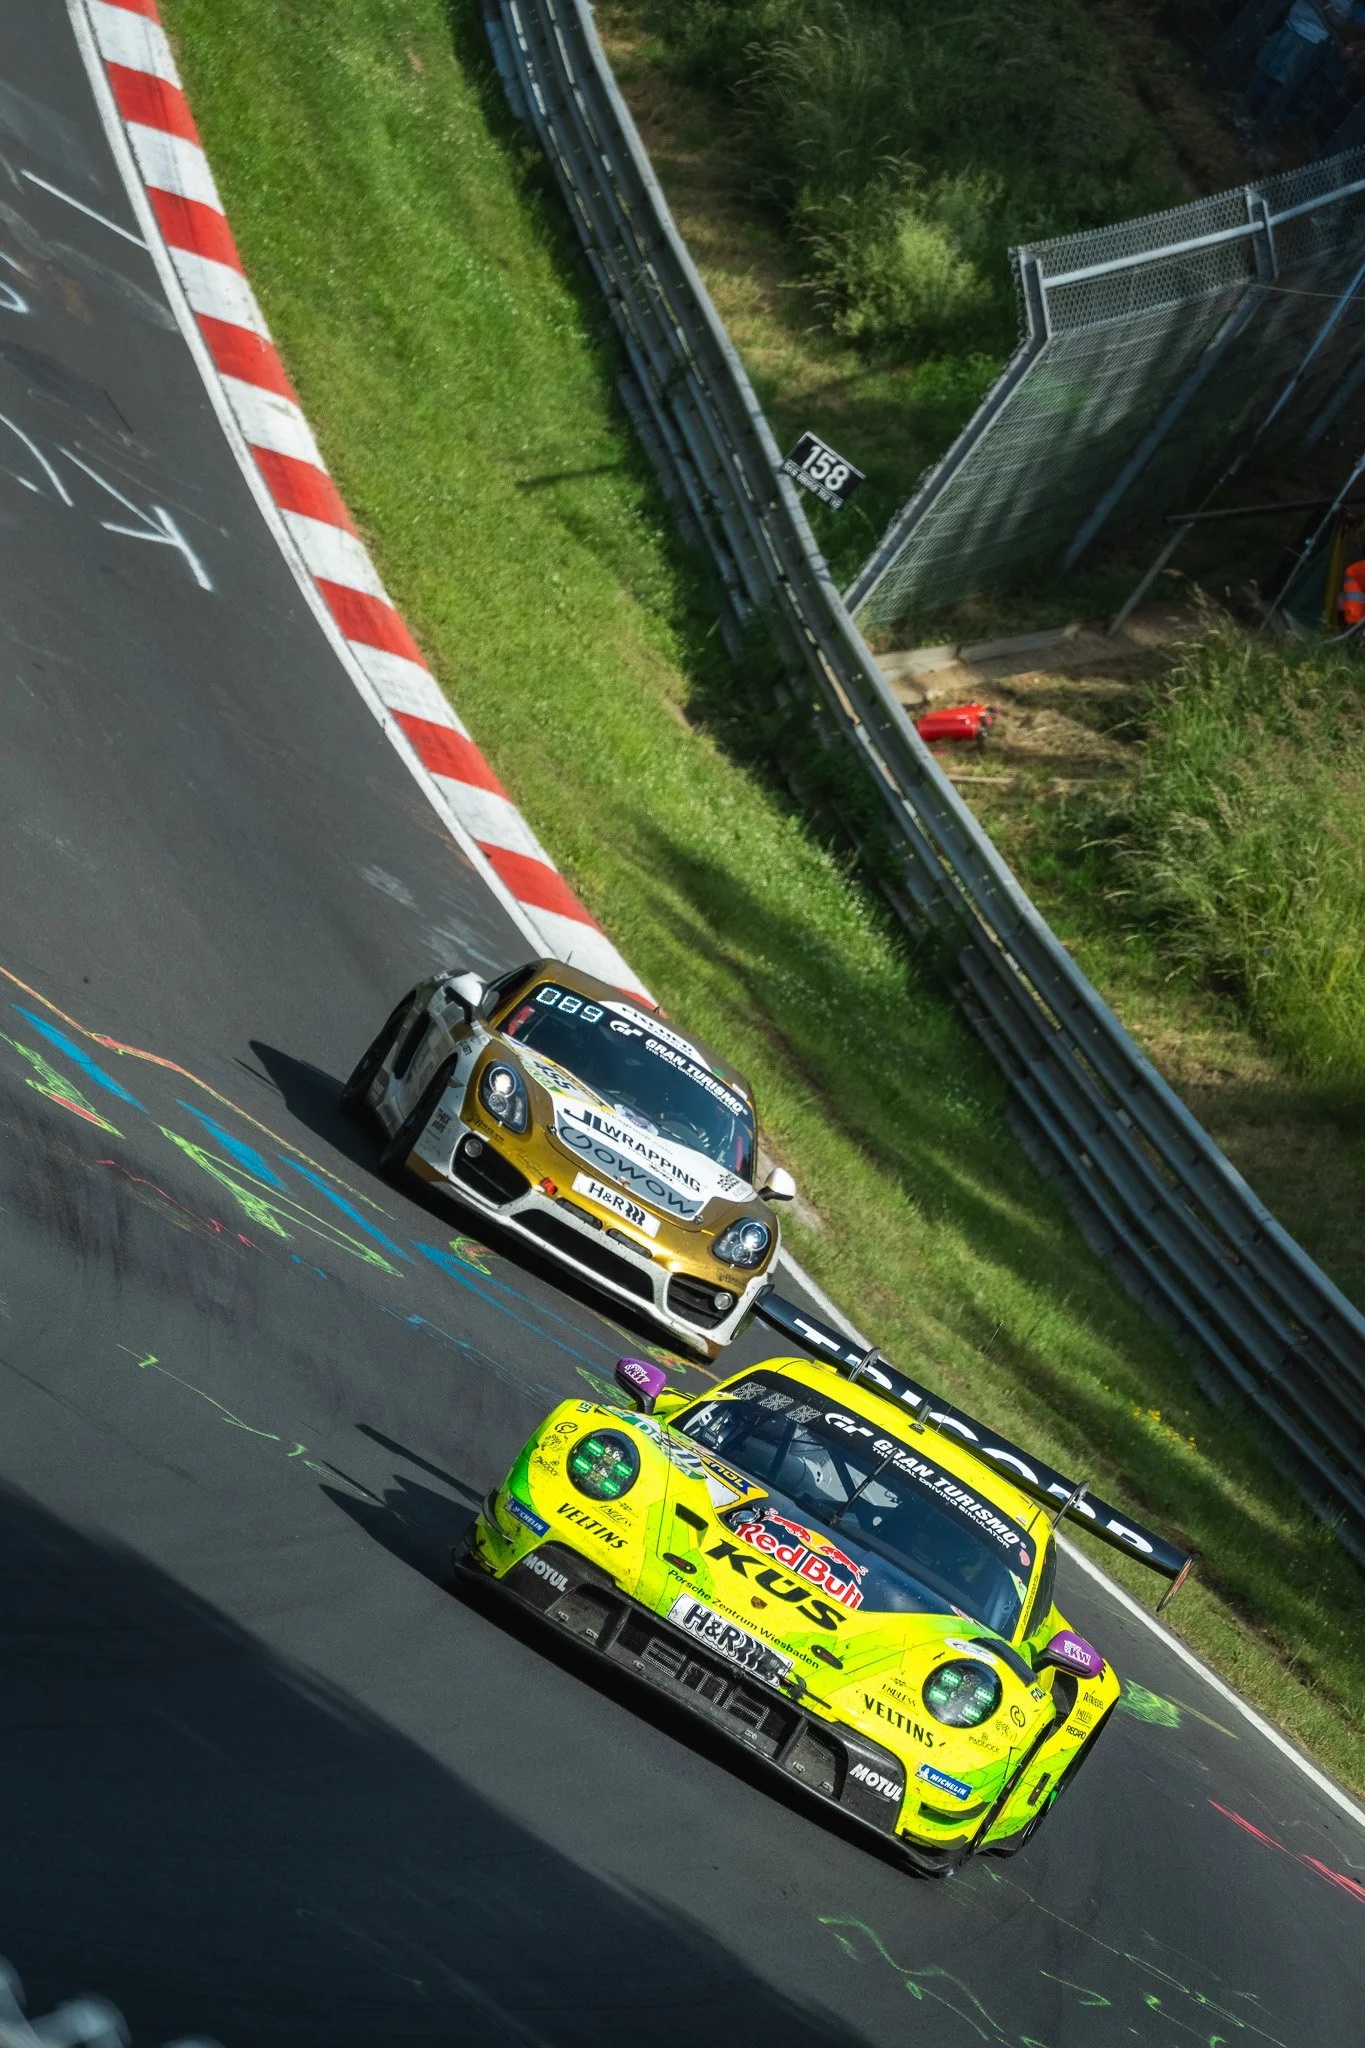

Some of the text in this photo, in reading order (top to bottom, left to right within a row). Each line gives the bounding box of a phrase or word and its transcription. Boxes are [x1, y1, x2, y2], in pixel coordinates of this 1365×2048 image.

[801, 445, 850, 491] 158
[645, 1039, 687, 1067] GRAN
[686, 1066, 745, 1114] TURISMO
[604, 1121, 701, 1193] WRAPPING
[589, 1182, 625, 1211] H&R
[512, 1506, 545, 1532] MICHELIN
[873, 1439, 1020, 1545] GRAN TURISMO
[892, 1459, 917, 1479] REAL
[918, 1478, 958, 1507] DRIVING
[958, 1505, 1011, 1549] SIMULATOR
[557, 1503, 628, 1549] VELTINS
[523, 1554, 569, 1592] MOTUL
[735, 1521, 865, 1610] Red Bull
[668, 1569, 820, 1669] Porsche Zentrum Wiesbaden
[683, 1603, 741, 1657] H&R
[863, 1693, 934, 1748] VELTINS
[849, 1763, 904, 1801] MOTUL
[929, 1773, 967, 1796] MICHELIN
